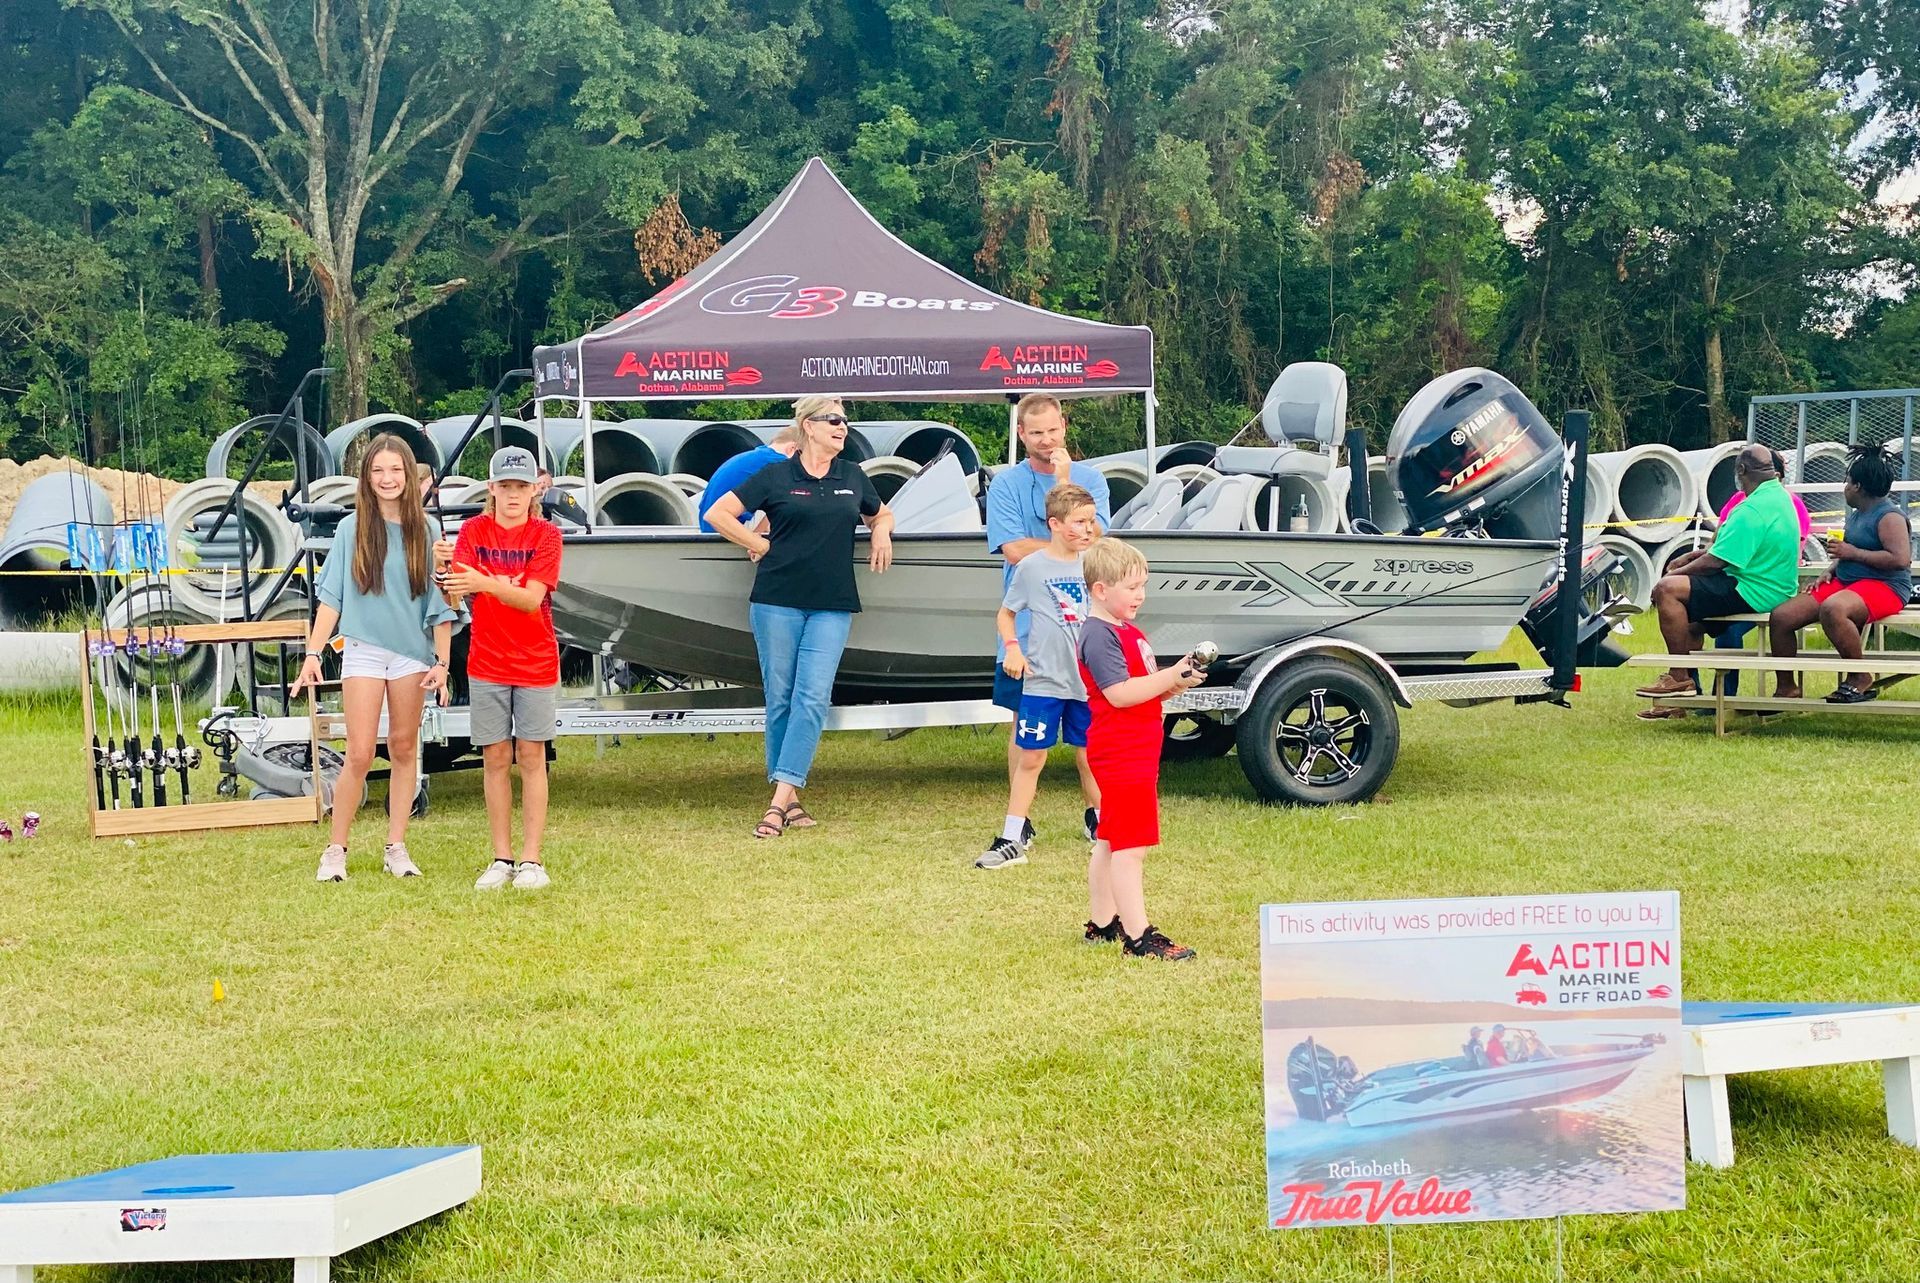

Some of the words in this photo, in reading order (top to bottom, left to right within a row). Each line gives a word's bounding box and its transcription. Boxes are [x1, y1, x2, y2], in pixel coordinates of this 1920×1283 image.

[700, 275, 847, 319] G3
[852, 291, 996, 312] Boats
[649, 350, 729, 369] ACTION
[1012, 345, 1088, 362] ACTION
[653, 369, 724, 382] MARINE
[801, 356, 949, 378] ACTIONMARINEDOTHAN.com
[1016, 362, 1083, 375] MARINE
[639, 383, 678, 394] Dothan,
[680, 383, 725, 393] Alabama
[1003, 376, 1041, 386] Dothan,
[1043, 376, 1084, 385] Alabama
[1461, 400, 1505, 437] YAMAHA
[1373, 558, 1475, 576] xpress
[1558, 537, 1569, 582] boats
[571, 720, 620, 728] BACK
[1277, 914, 1315, 934] This
[1321, 912, 1386, 935] activity
[1393, 913, 1430, 929] was
[1438, 907, 1515, 933] provided
[1522, 904, 1568, 925] FREE
[1574, 905, 1592, 923] to
[1598, 906, 1632, 926] you
[1549, 940, 1670, 970] ACTION
[1559, 971, 1640, 987] MARINE
[1559, 991, 1590, 1004] OFF
[1596, 989, 1642, 1003] ROAD
[1328, 1159, 1413, 1179] Rehobeth
[1275, 1183, 1363, 1227] True
[1343, 1174, 1473, 1224] Value
